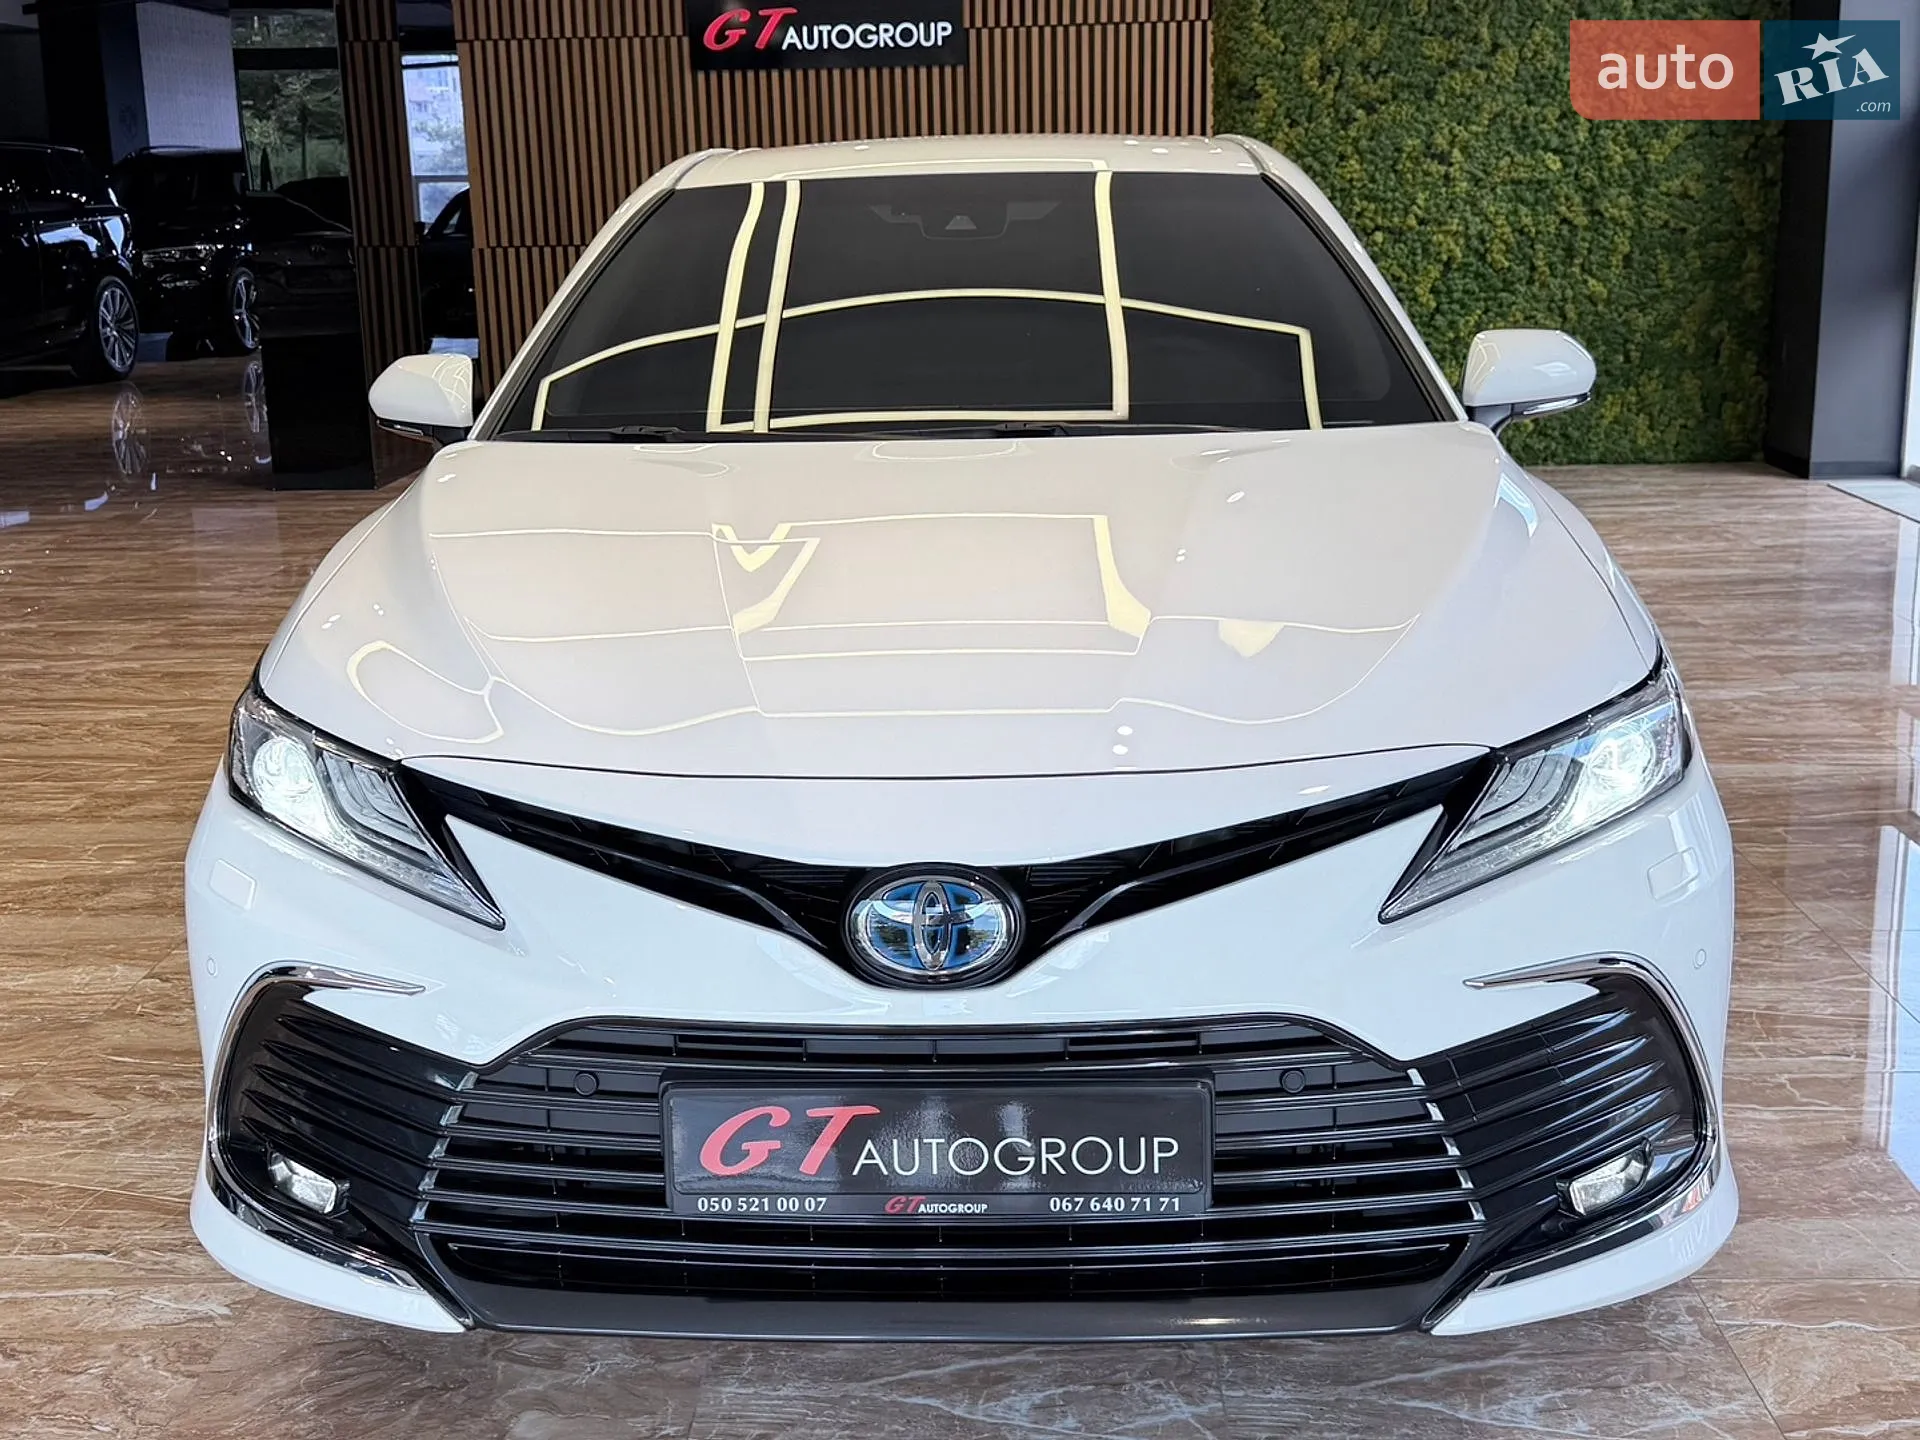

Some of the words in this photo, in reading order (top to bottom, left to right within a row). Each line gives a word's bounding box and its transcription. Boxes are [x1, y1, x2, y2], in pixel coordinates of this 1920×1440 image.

[703, 7, 798, 50] GT
[781, 21, 952, 50] AUTOGROUP
[700, 1105, 881, 1176] GT
[852, 1137, 1179, 1177] AUTOGROUP
[697, 1196, 732, 1213] 050
[737, 1196, 769, 1213] 521
[777, 1196, 799, 1213] 00
[804, 1196, 828, 1213] 07
[884, 1195, 927, 1215] GT
[918, 1202, 988, 1214] AUTOGROUP
[1049, 1196, 1084, 1213] 067
[1089, 1196, 1125, 1213] 640
[1130, 1196, 1151, 1213] 71
[1159, 1196, 1180, 1213] 71
